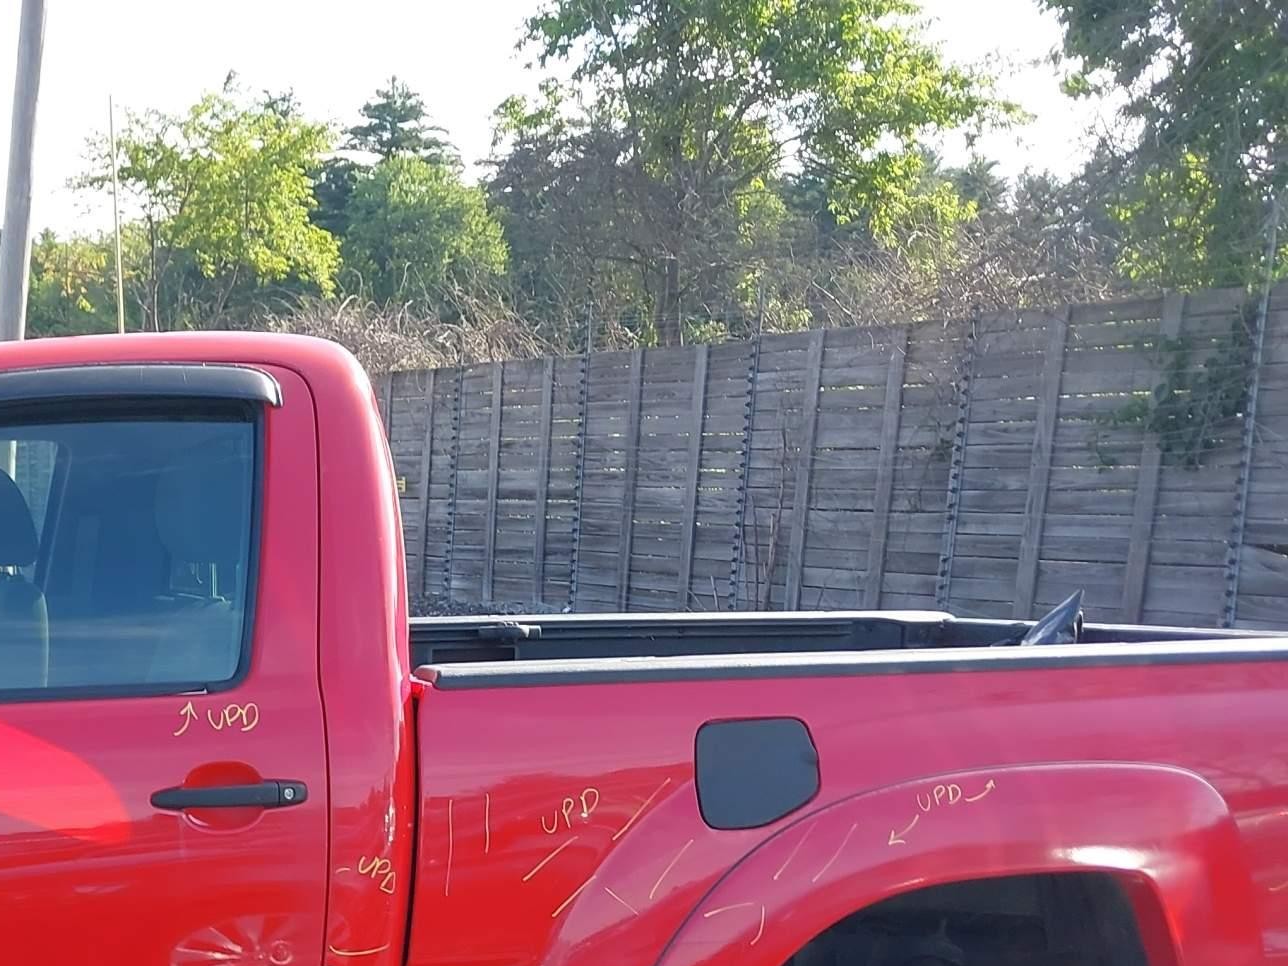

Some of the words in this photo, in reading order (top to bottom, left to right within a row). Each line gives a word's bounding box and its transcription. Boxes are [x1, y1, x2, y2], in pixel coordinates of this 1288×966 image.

[207, 702, 259, 732] UPD
[541, 788, 600, 834] UPD
[916, 783, 962, 812] UPD
[358, 855, 396, 894] UPD
